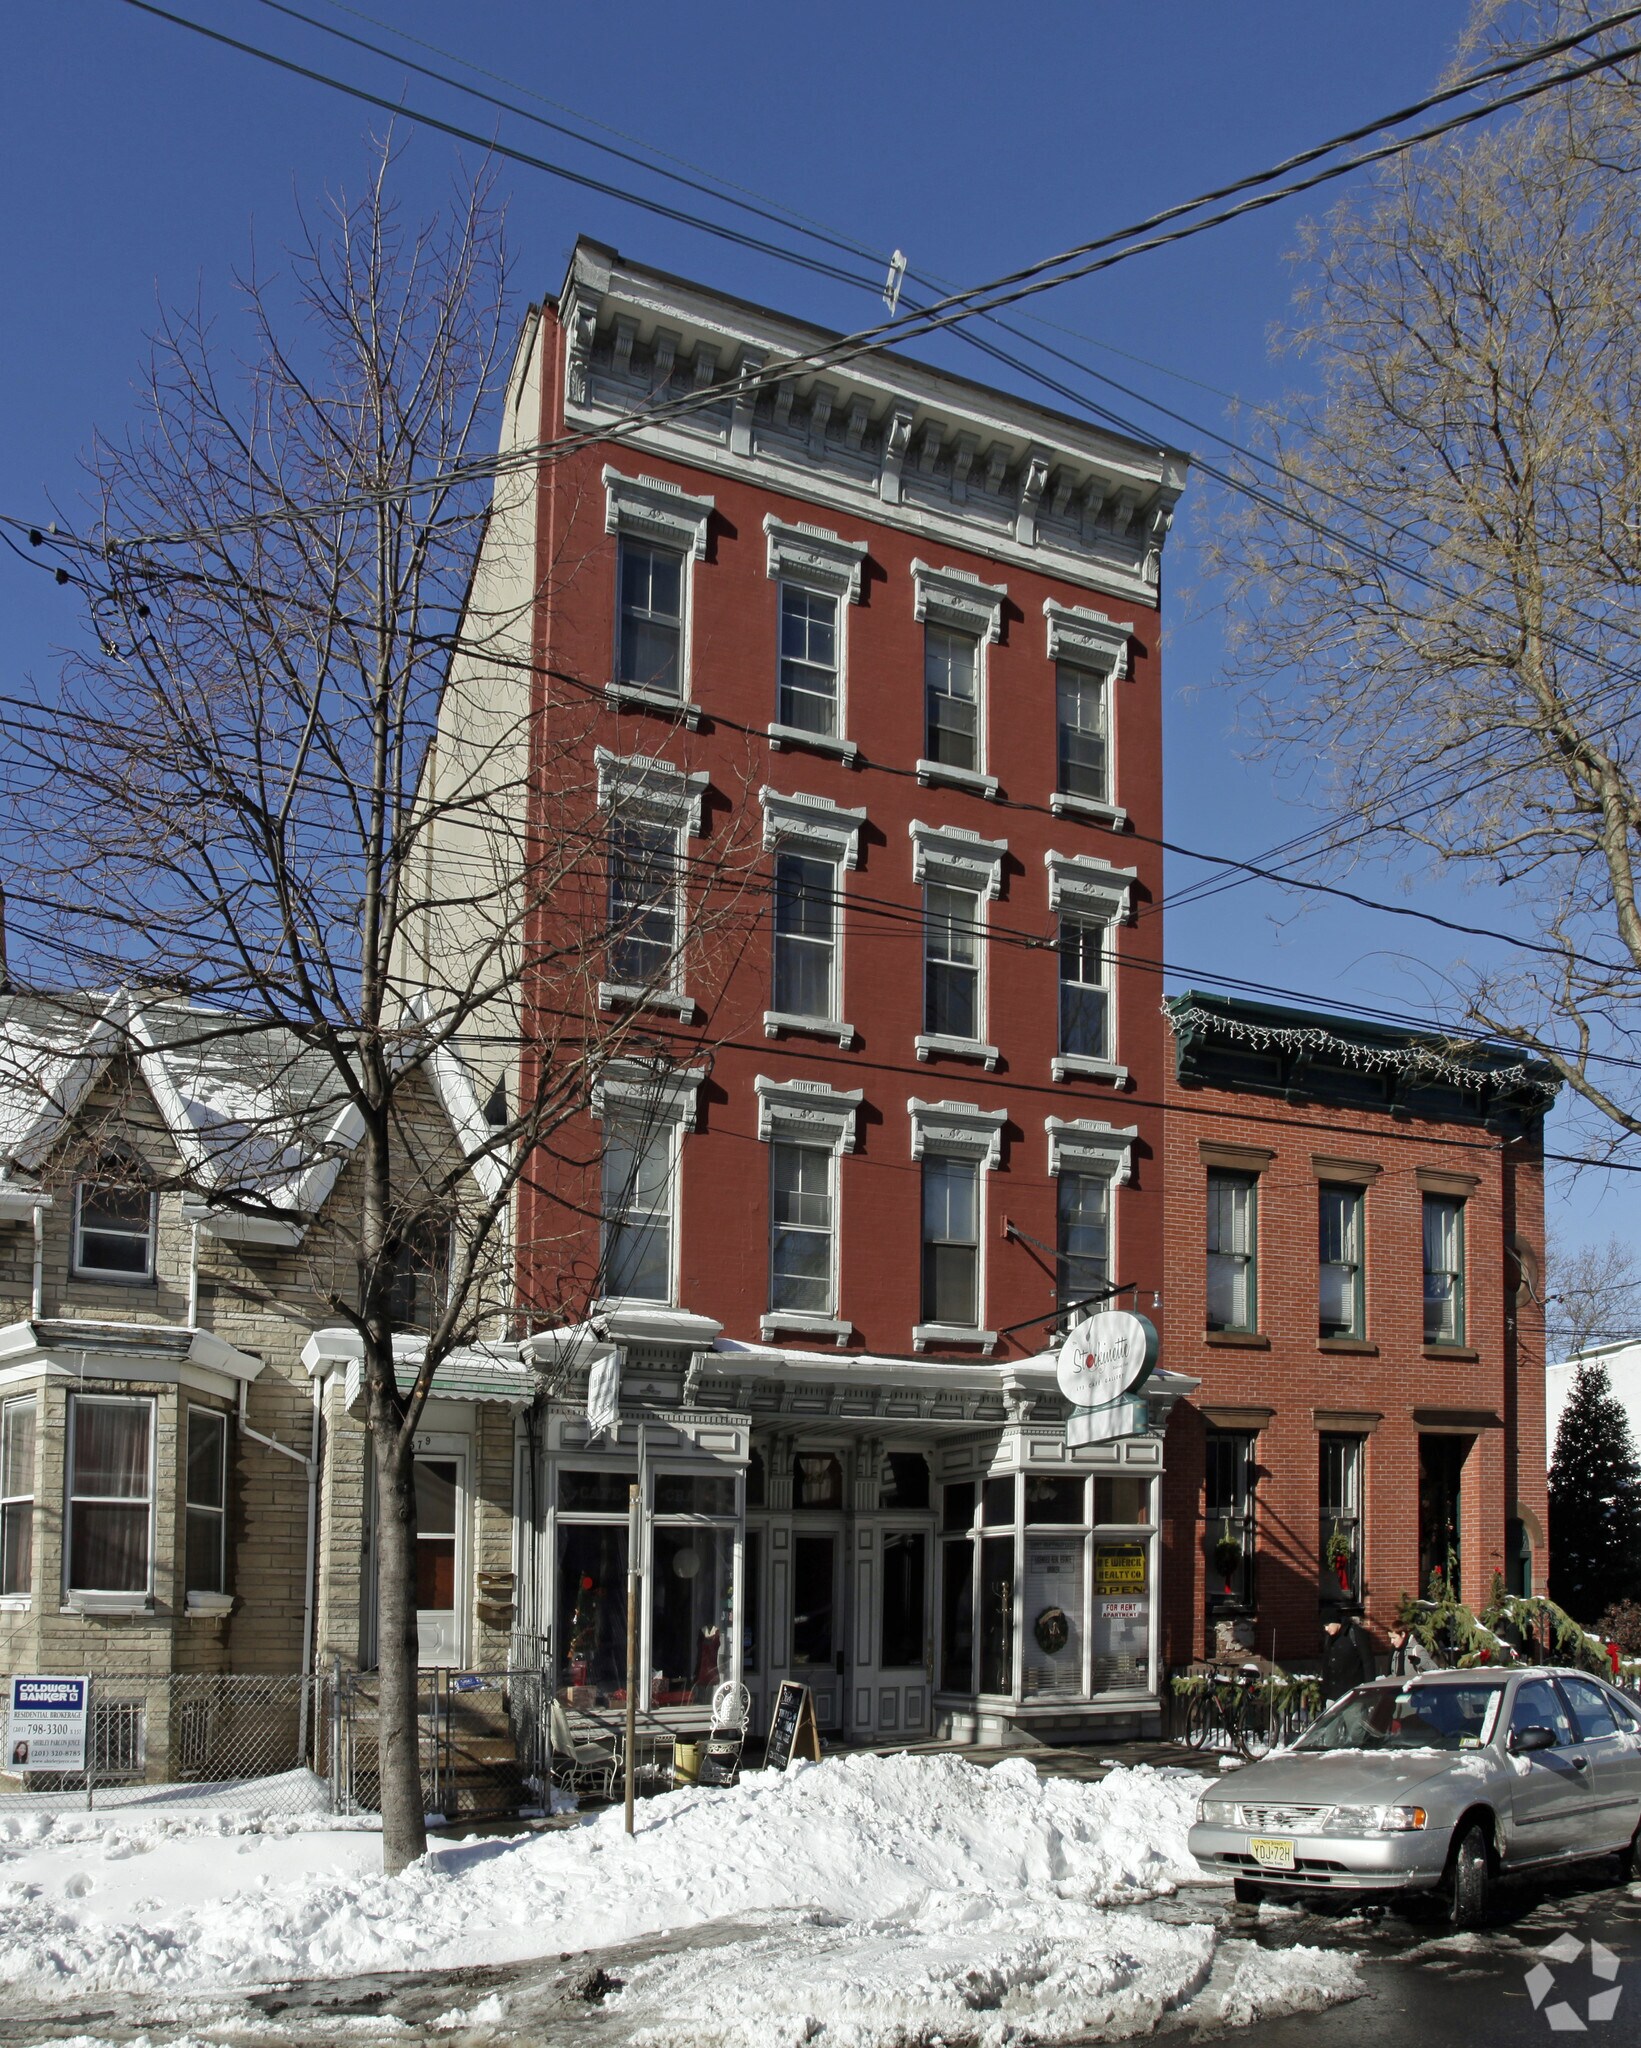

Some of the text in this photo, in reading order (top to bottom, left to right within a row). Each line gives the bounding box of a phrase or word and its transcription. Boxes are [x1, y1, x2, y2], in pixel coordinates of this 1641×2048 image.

[1097, 1586, 1143, 1595] OPEN
[1106, 1603, 1137, 1611] FOR RENT
[27, 1723, 68, 1735] 798-3300
